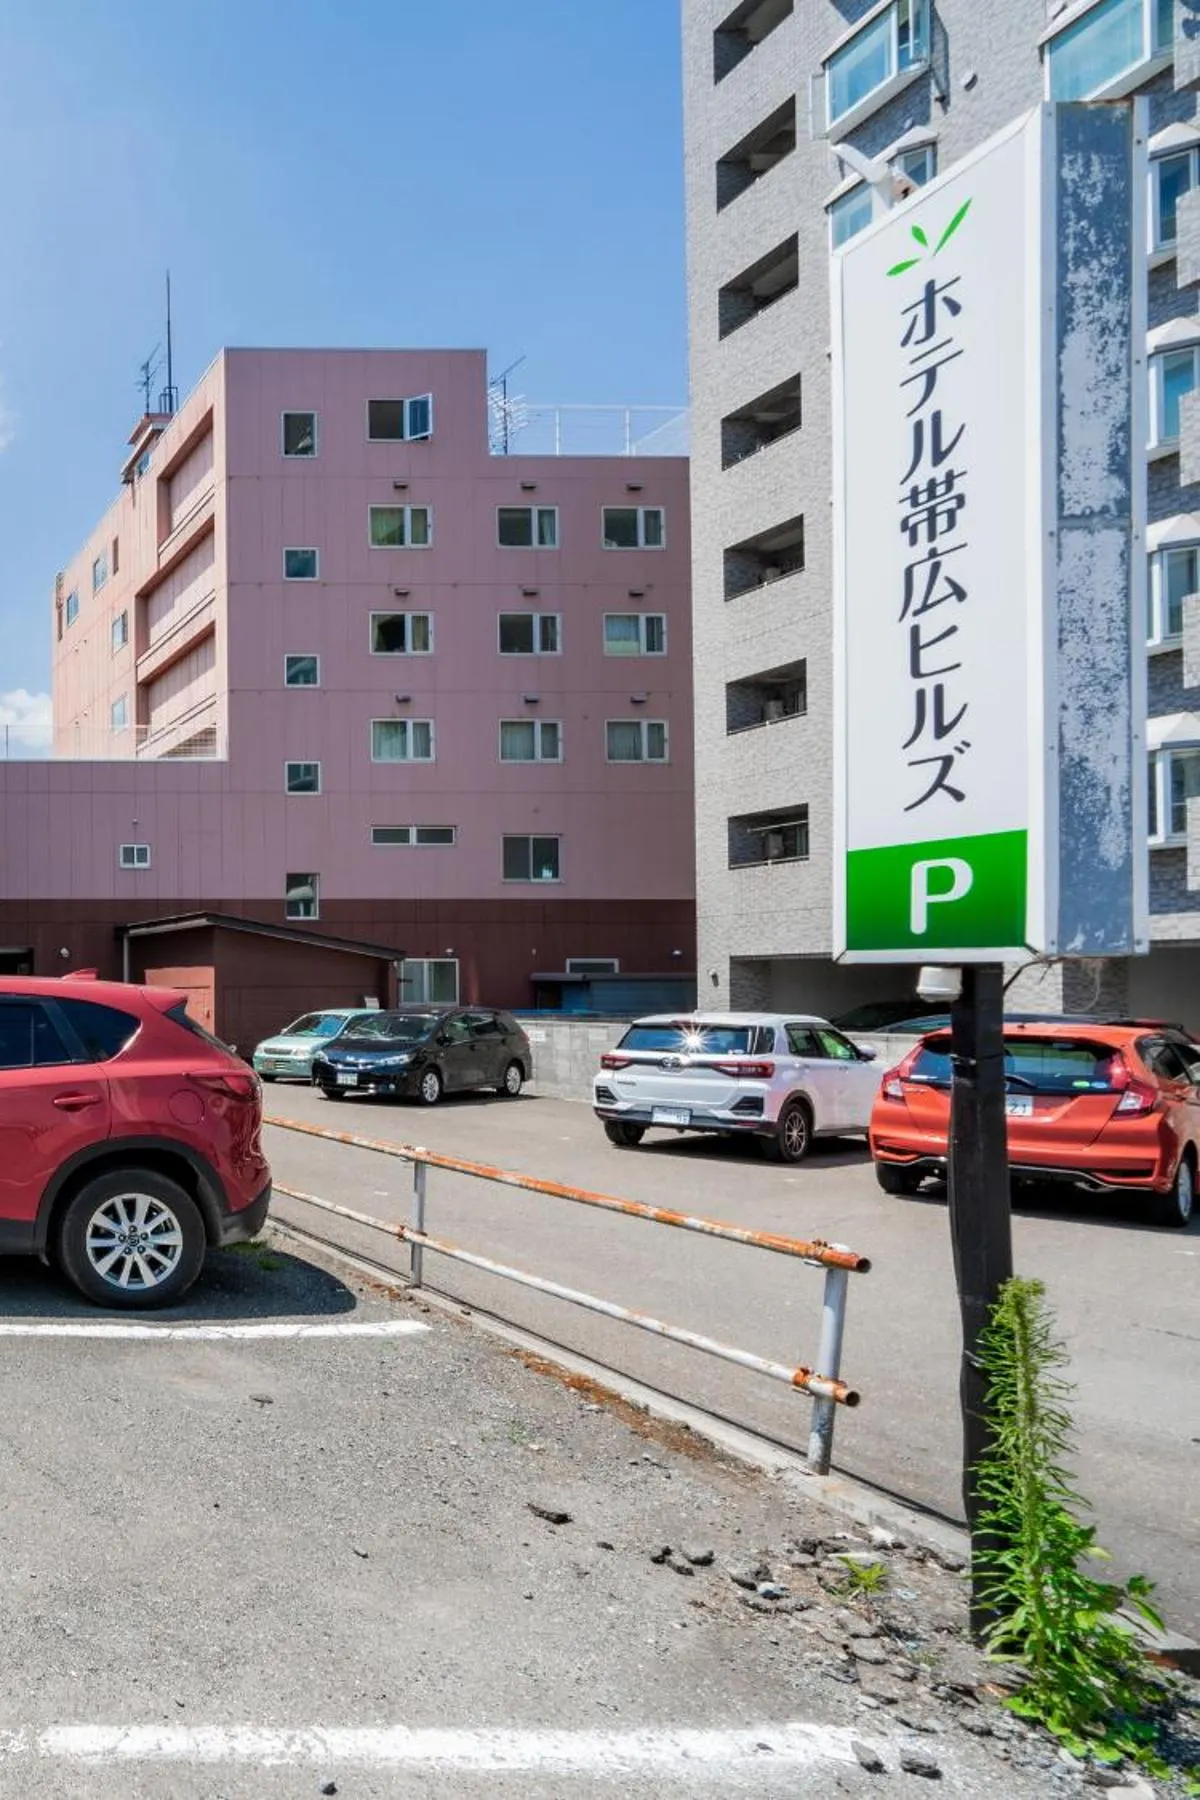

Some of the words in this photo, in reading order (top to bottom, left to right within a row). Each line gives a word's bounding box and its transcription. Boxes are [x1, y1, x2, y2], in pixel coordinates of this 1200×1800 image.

[898, 275, 970, 813] ホテル帯広ヒルズ
[910, 857, 973, 935] P
